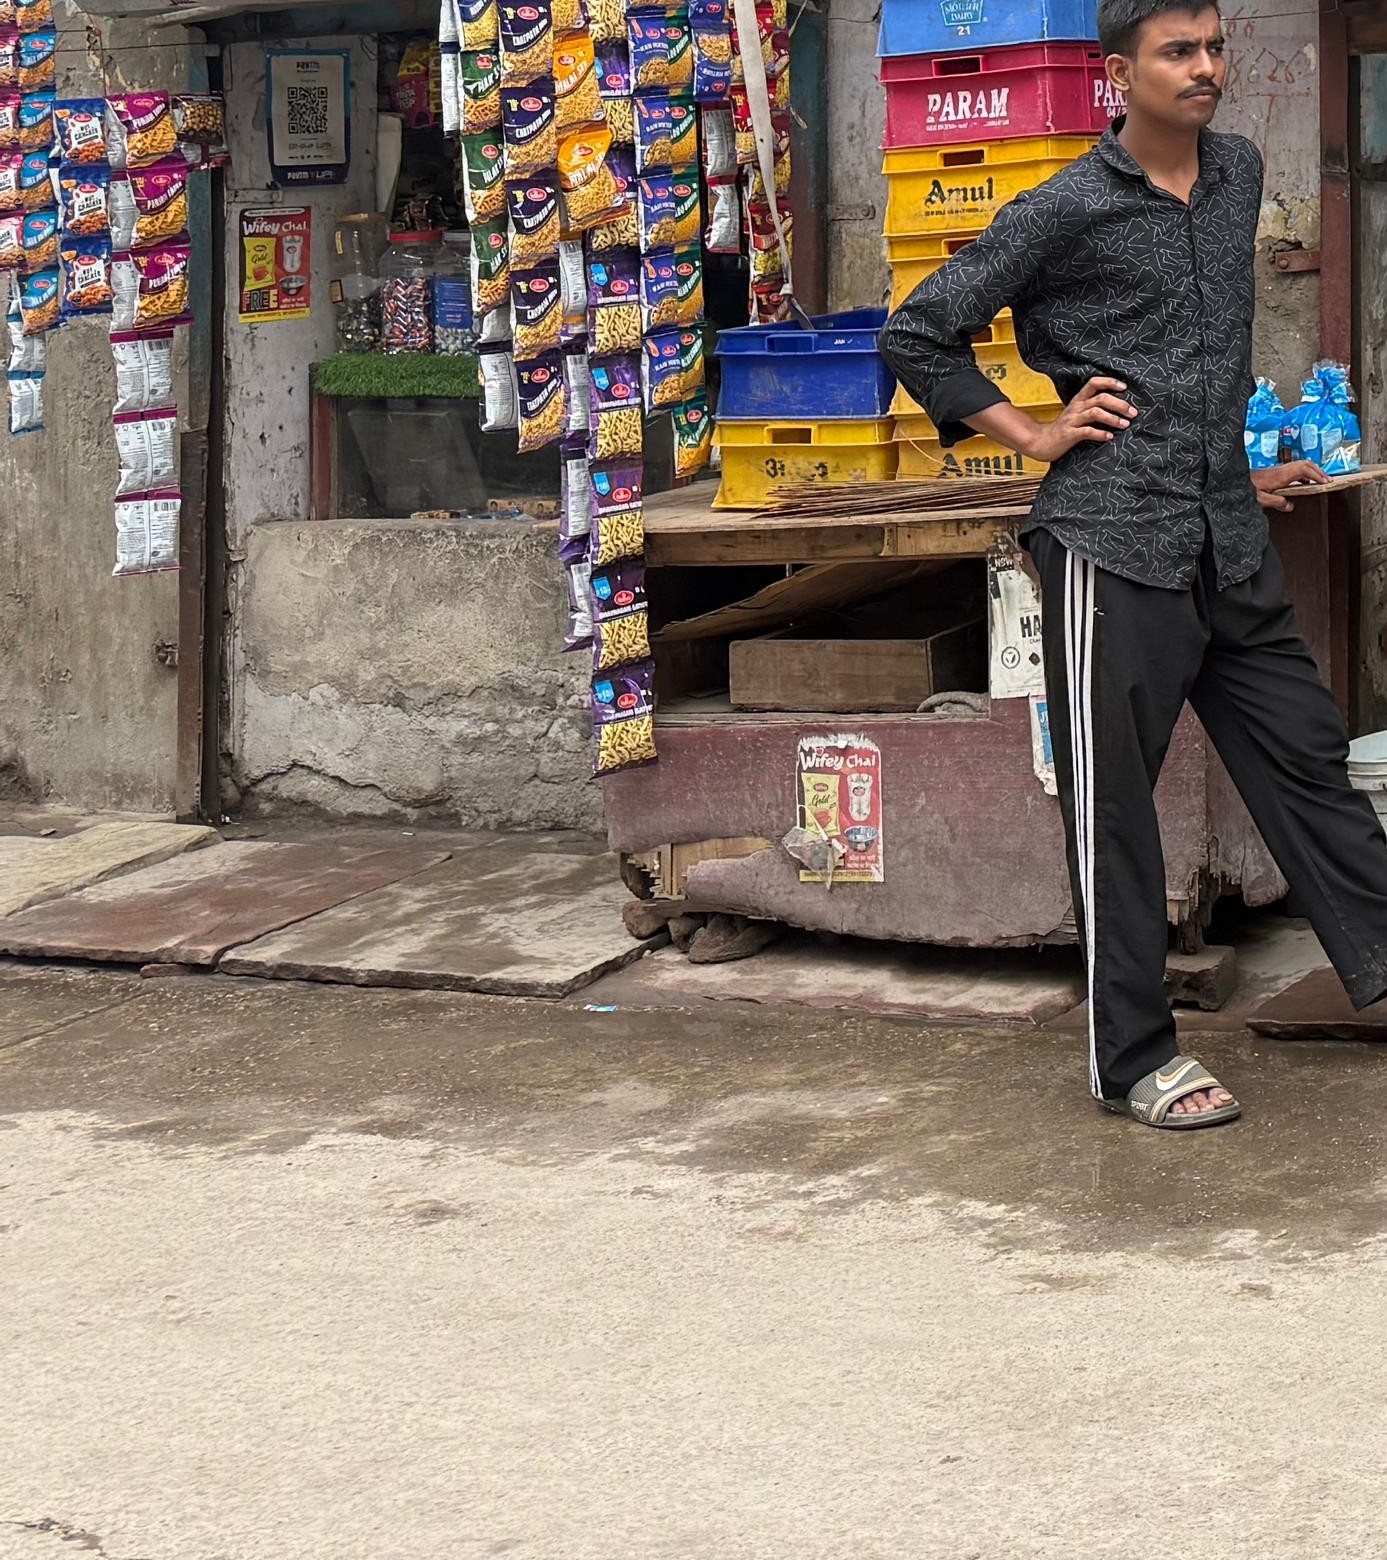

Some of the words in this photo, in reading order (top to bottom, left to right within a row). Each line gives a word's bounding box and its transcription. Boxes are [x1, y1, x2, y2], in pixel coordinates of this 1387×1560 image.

[957, 25, 971, 36] 21
[926, 88, 1010, 124] PARAM
[924, 176, 995, 207] Amul
[242, 220, 281, 236] Wifey
[281, 218, 308, 233] Chai
[251, 252, 268, 264] Gold
[242, 289, 279, 312] FREE
[938, 452, 1025, 478] Amul
[1019, 615, 1042, 639] HA
[800, 752, 844, 771] Wifey
[845, 754, 876, 769] Chai
[811, 793, 831, 808] Gold
